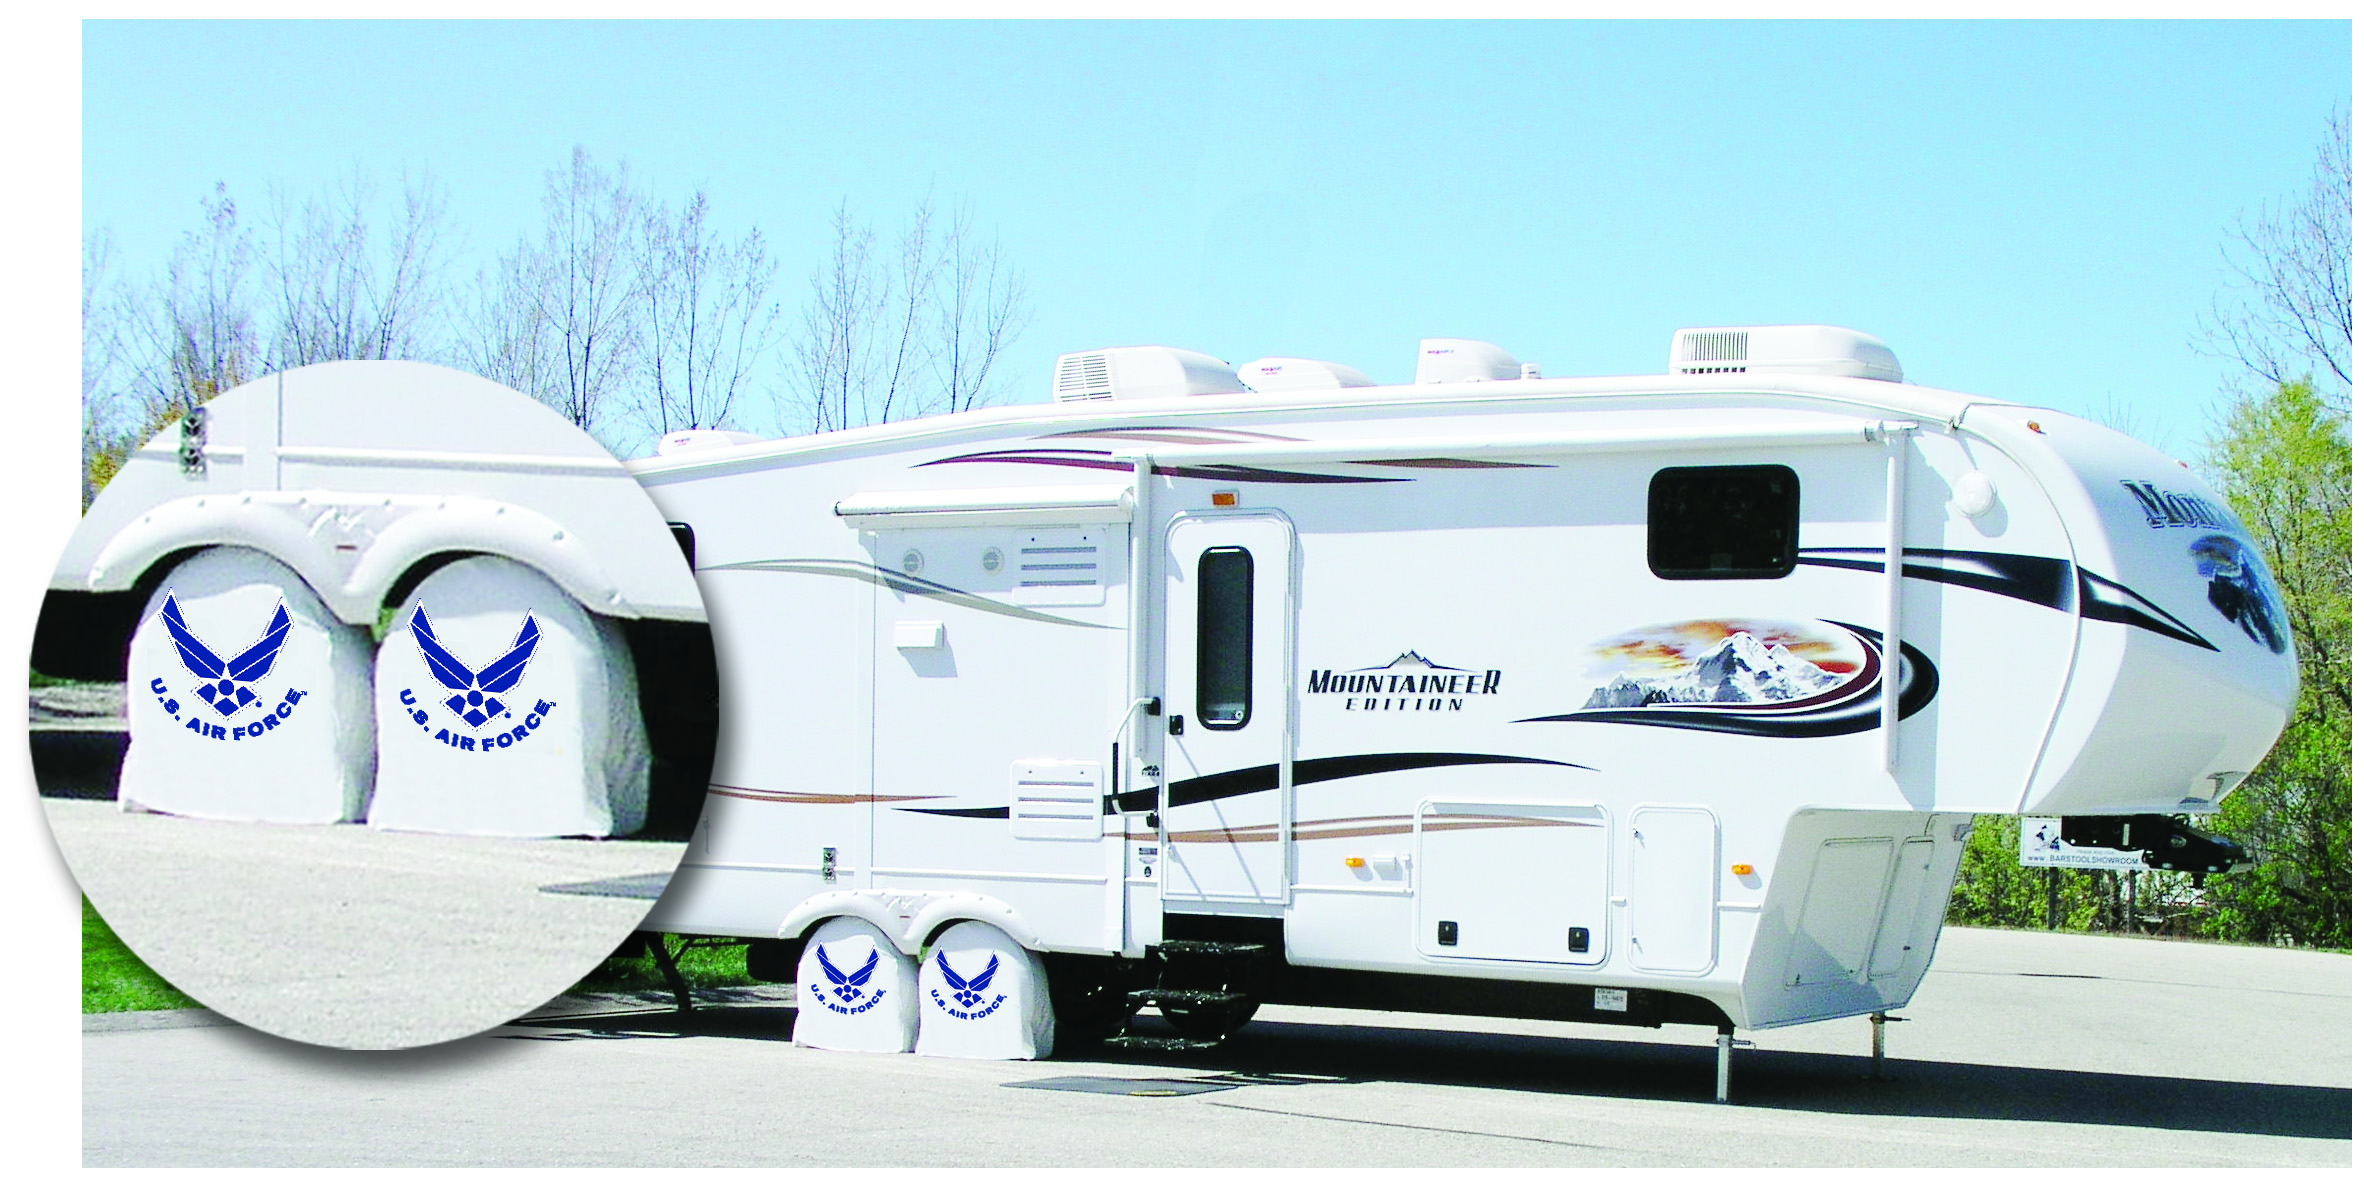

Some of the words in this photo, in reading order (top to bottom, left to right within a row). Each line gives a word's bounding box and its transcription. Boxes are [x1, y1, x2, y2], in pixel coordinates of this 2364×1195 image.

[1308, 669, 1501, 694] MOUNTAINEER
[151, 677, 181, 722] U.S.
[186, 717, 227, 741] AIR
[400, 688, 430, 732] U.S.
[434, 728, 476, 752] AIR
[1345, 697, 1463, 711] EDITION
[2049, 854, 2139, 865] BARSTOOLSHOWROOM
[811, 983, 826, 1005] U.S.
[828, 1002, 848, 1015] AIR
[930, 988, 946, 1011] U.S.
[947, 1008, 968, 1021] AIR
